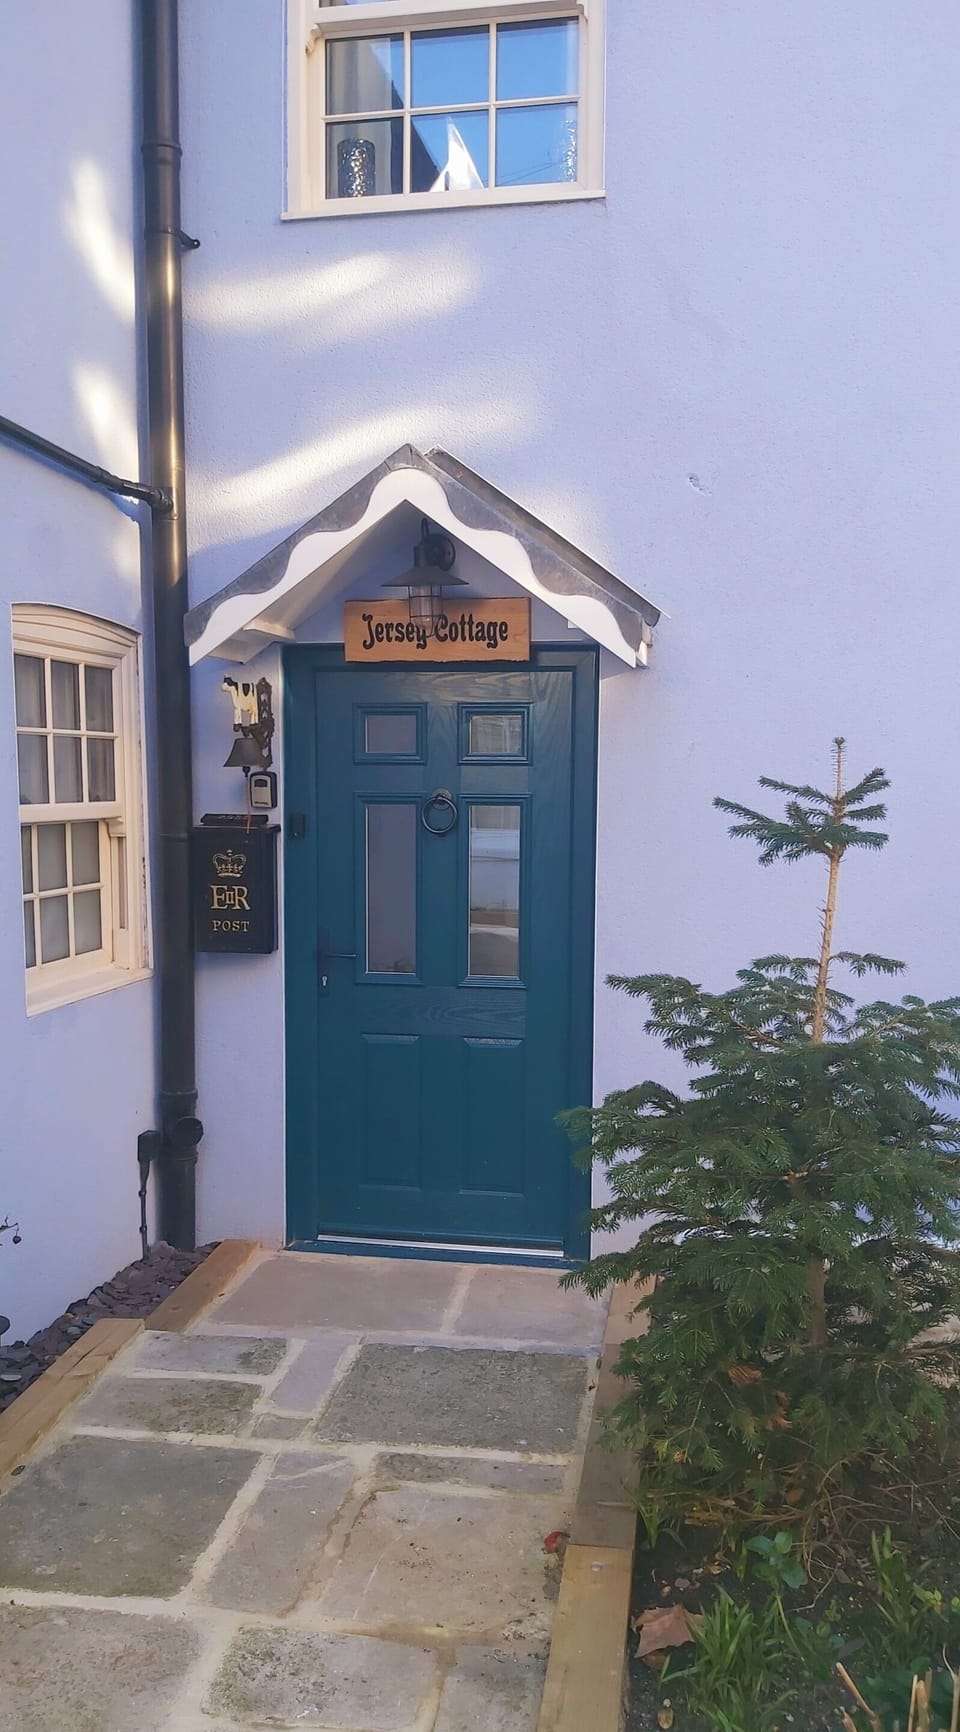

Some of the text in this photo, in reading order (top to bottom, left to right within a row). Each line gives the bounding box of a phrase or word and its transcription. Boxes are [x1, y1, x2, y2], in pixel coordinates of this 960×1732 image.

[362, 613, 508, 649] Jersey Cottage
[212, 920, 250, 932] POST
